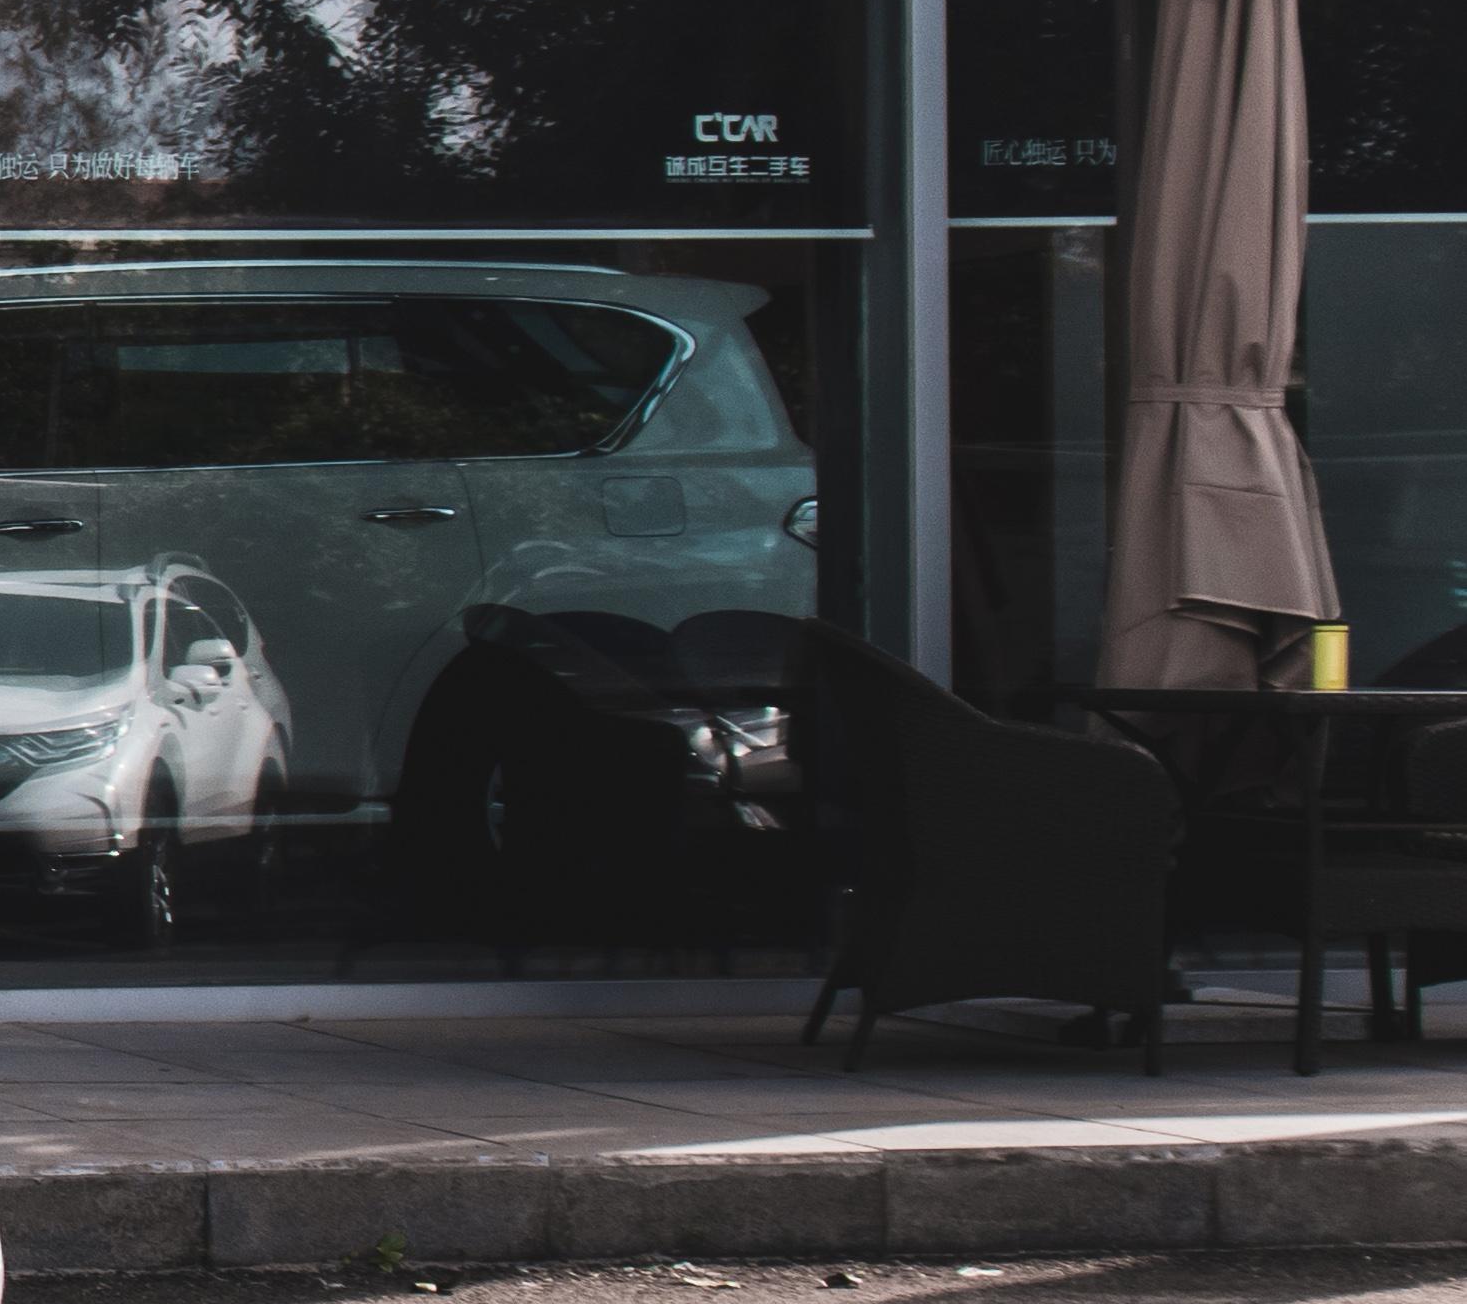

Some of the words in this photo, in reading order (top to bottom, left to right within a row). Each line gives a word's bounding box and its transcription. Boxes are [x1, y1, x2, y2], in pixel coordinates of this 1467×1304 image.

[665, 156, 810, 176] 诚成互生二手车
[983, 138, 1067, 166] 匠心独运
[49, 152, 201, 182] 只为做好每辆车
